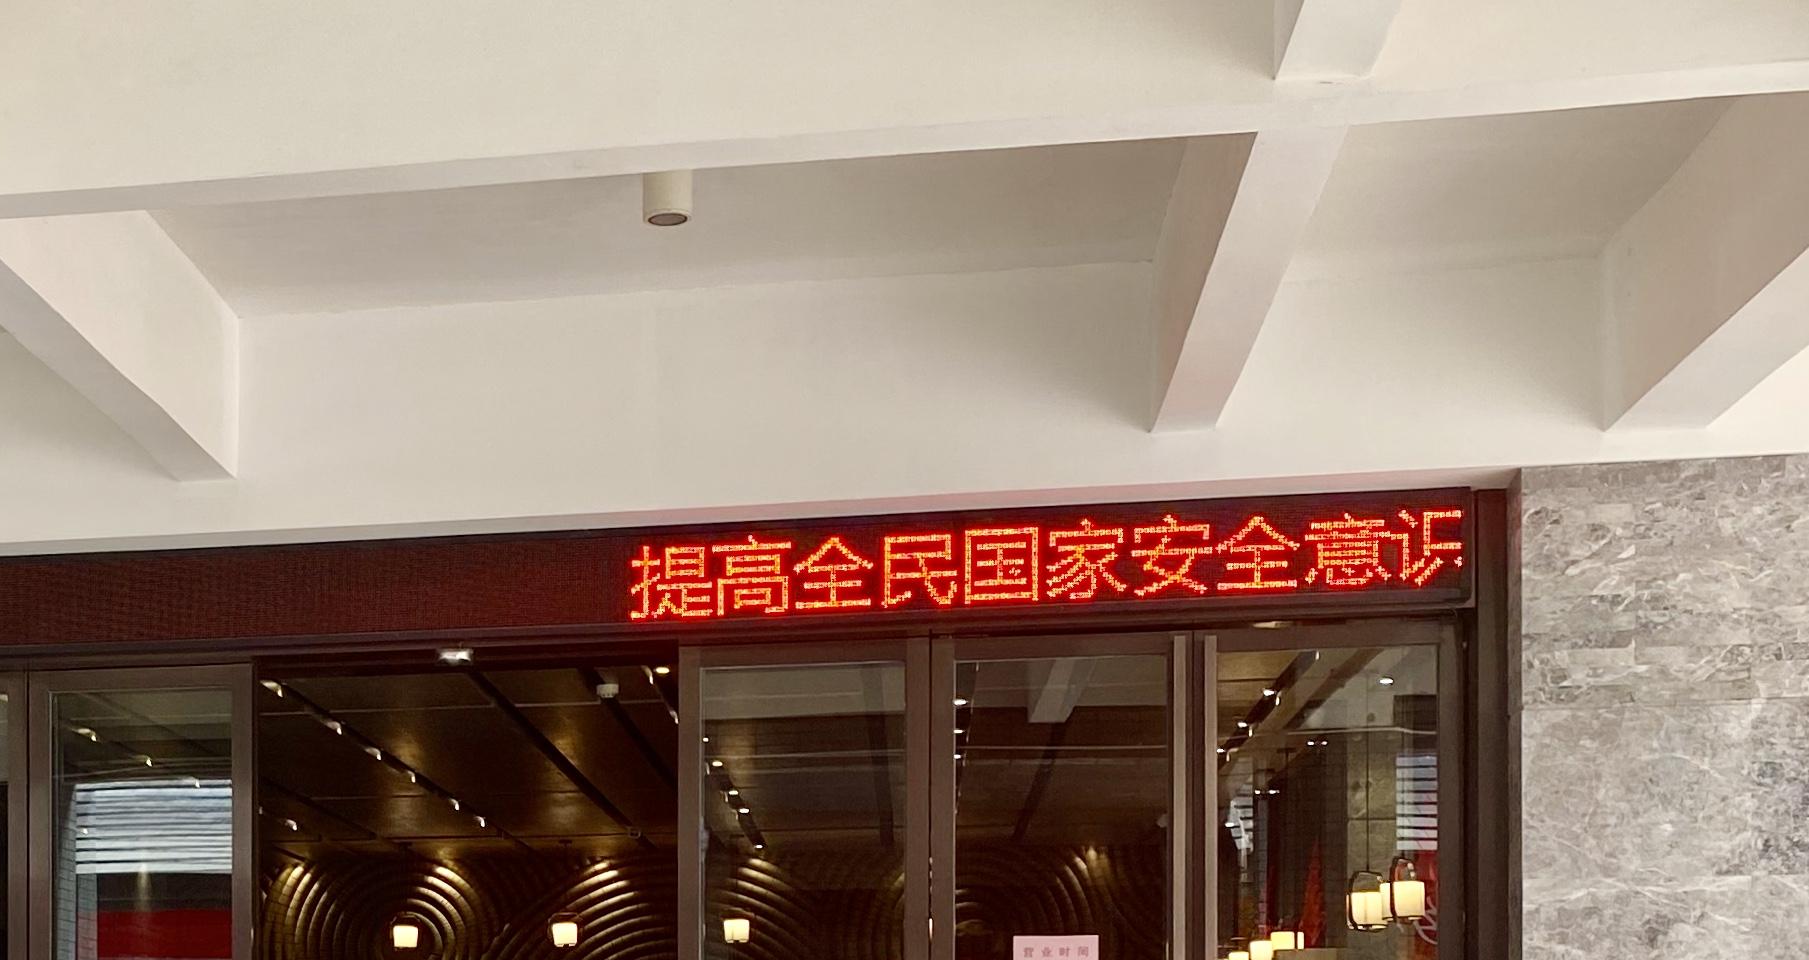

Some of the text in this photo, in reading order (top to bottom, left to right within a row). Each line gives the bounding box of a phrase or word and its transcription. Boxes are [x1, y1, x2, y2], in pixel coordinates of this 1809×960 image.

[630, 508, 1463, 619] 提高全民国家安全意识
